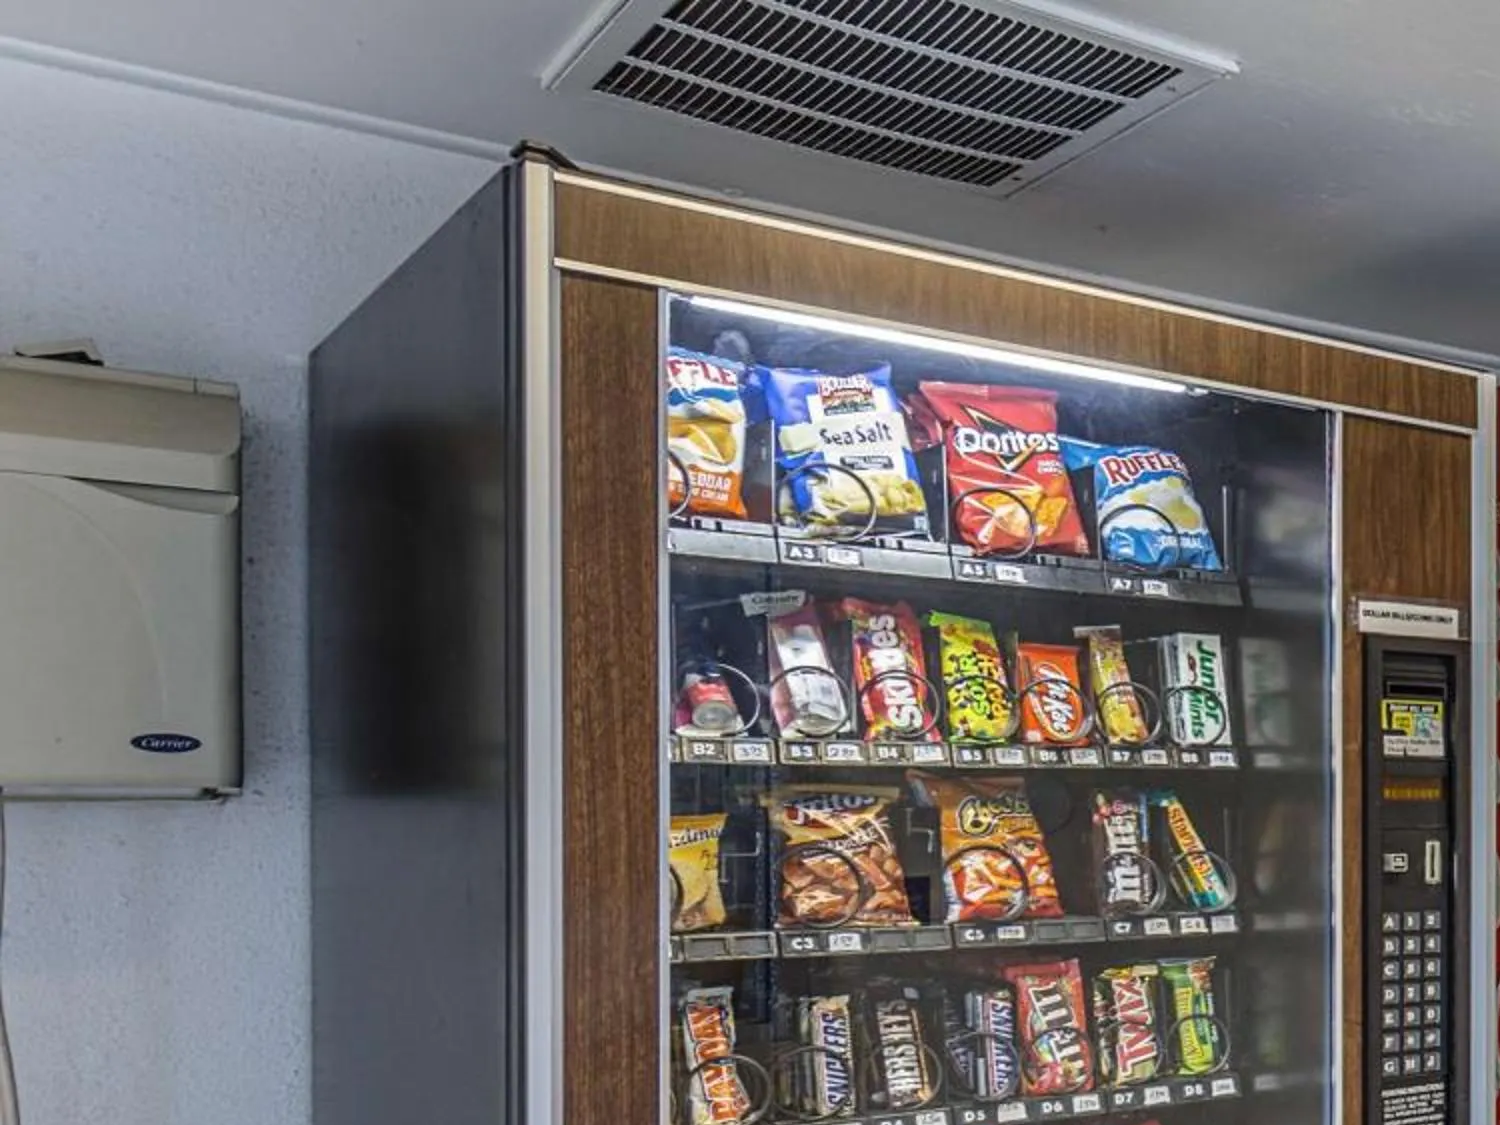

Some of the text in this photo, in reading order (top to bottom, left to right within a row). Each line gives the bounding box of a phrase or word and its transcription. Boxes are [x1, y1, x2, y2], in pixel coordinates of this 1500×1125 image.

[819, 419, 893, 446] Sea Salt
[953, 425, 1060, 453] Doritos
[788, 549, 815, 561] A3
[961, 563, 985, 577] A5
[1112, 579, 1132, 592] A7
[1195, 640, 1221, 726] Junior
[140, 736, 193, 749] Carrier
[693, 743, 716, 755] B2
[791, 938, 815, 950] C3
[821, 1011, 850, 1110] SNICKERS
[1184, 1084, 1204, 1097] D8
[1114, 1093, 1134, 1105] D7
[1042, 1102, 1063, 1114] D6
[964, 1110, 986, 1122] D5
